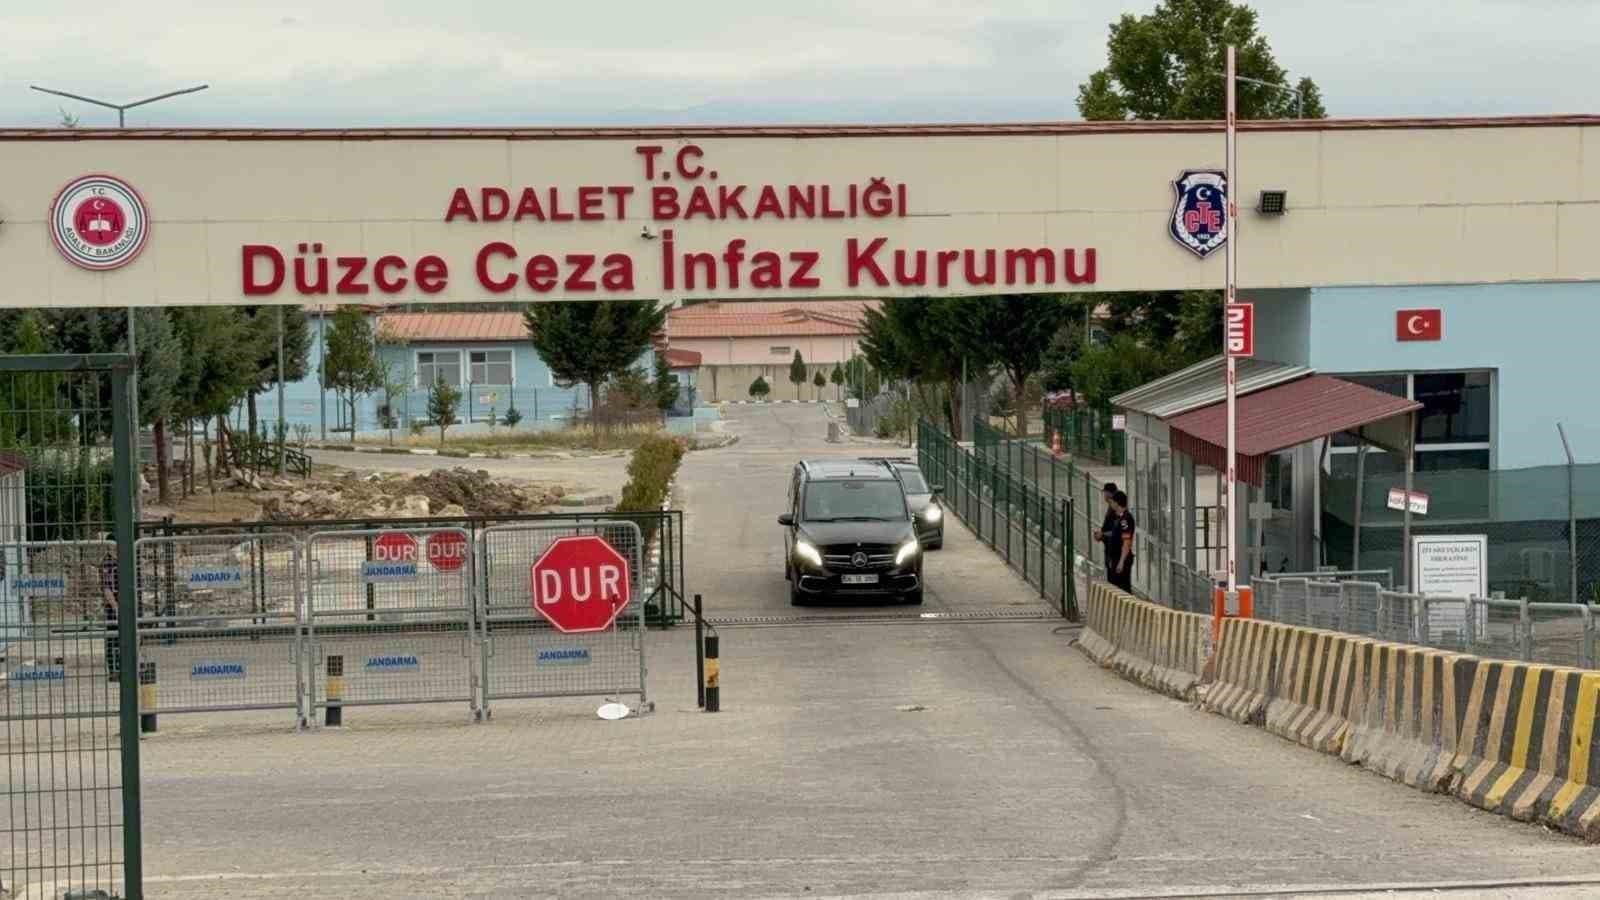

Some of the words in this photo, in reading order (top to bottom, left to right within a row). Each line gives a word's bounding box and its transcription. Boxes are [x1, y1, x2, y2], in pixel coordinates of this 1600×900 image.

[636, 145, 718, 181] T.C.
[445, 186, 634, 222] ADALET
[651, 177, 907, 220] BAKANLIĞI
[65, 226, 93, 255] ADALET
[242, 243, 449, 297] Düzce
[475, 241, 635, 293] Ceza
[661, 229, 821, 291] İnfaz
[846, 236, 1097, 288] Kurumu
[375, 544, 417, 561] DUR
[429, 542, 467, 559] DUR
[365, 564, 417, 577] JANDARMA
[12, 578, 65, 589] JANDARMA
[541, 564, 621, 604] DUR
[366, 655, 418, 668] JANDARMA
[538, 648, 589, 661] JANDARMA
[191, 663, 244, 676] JANDARMA
